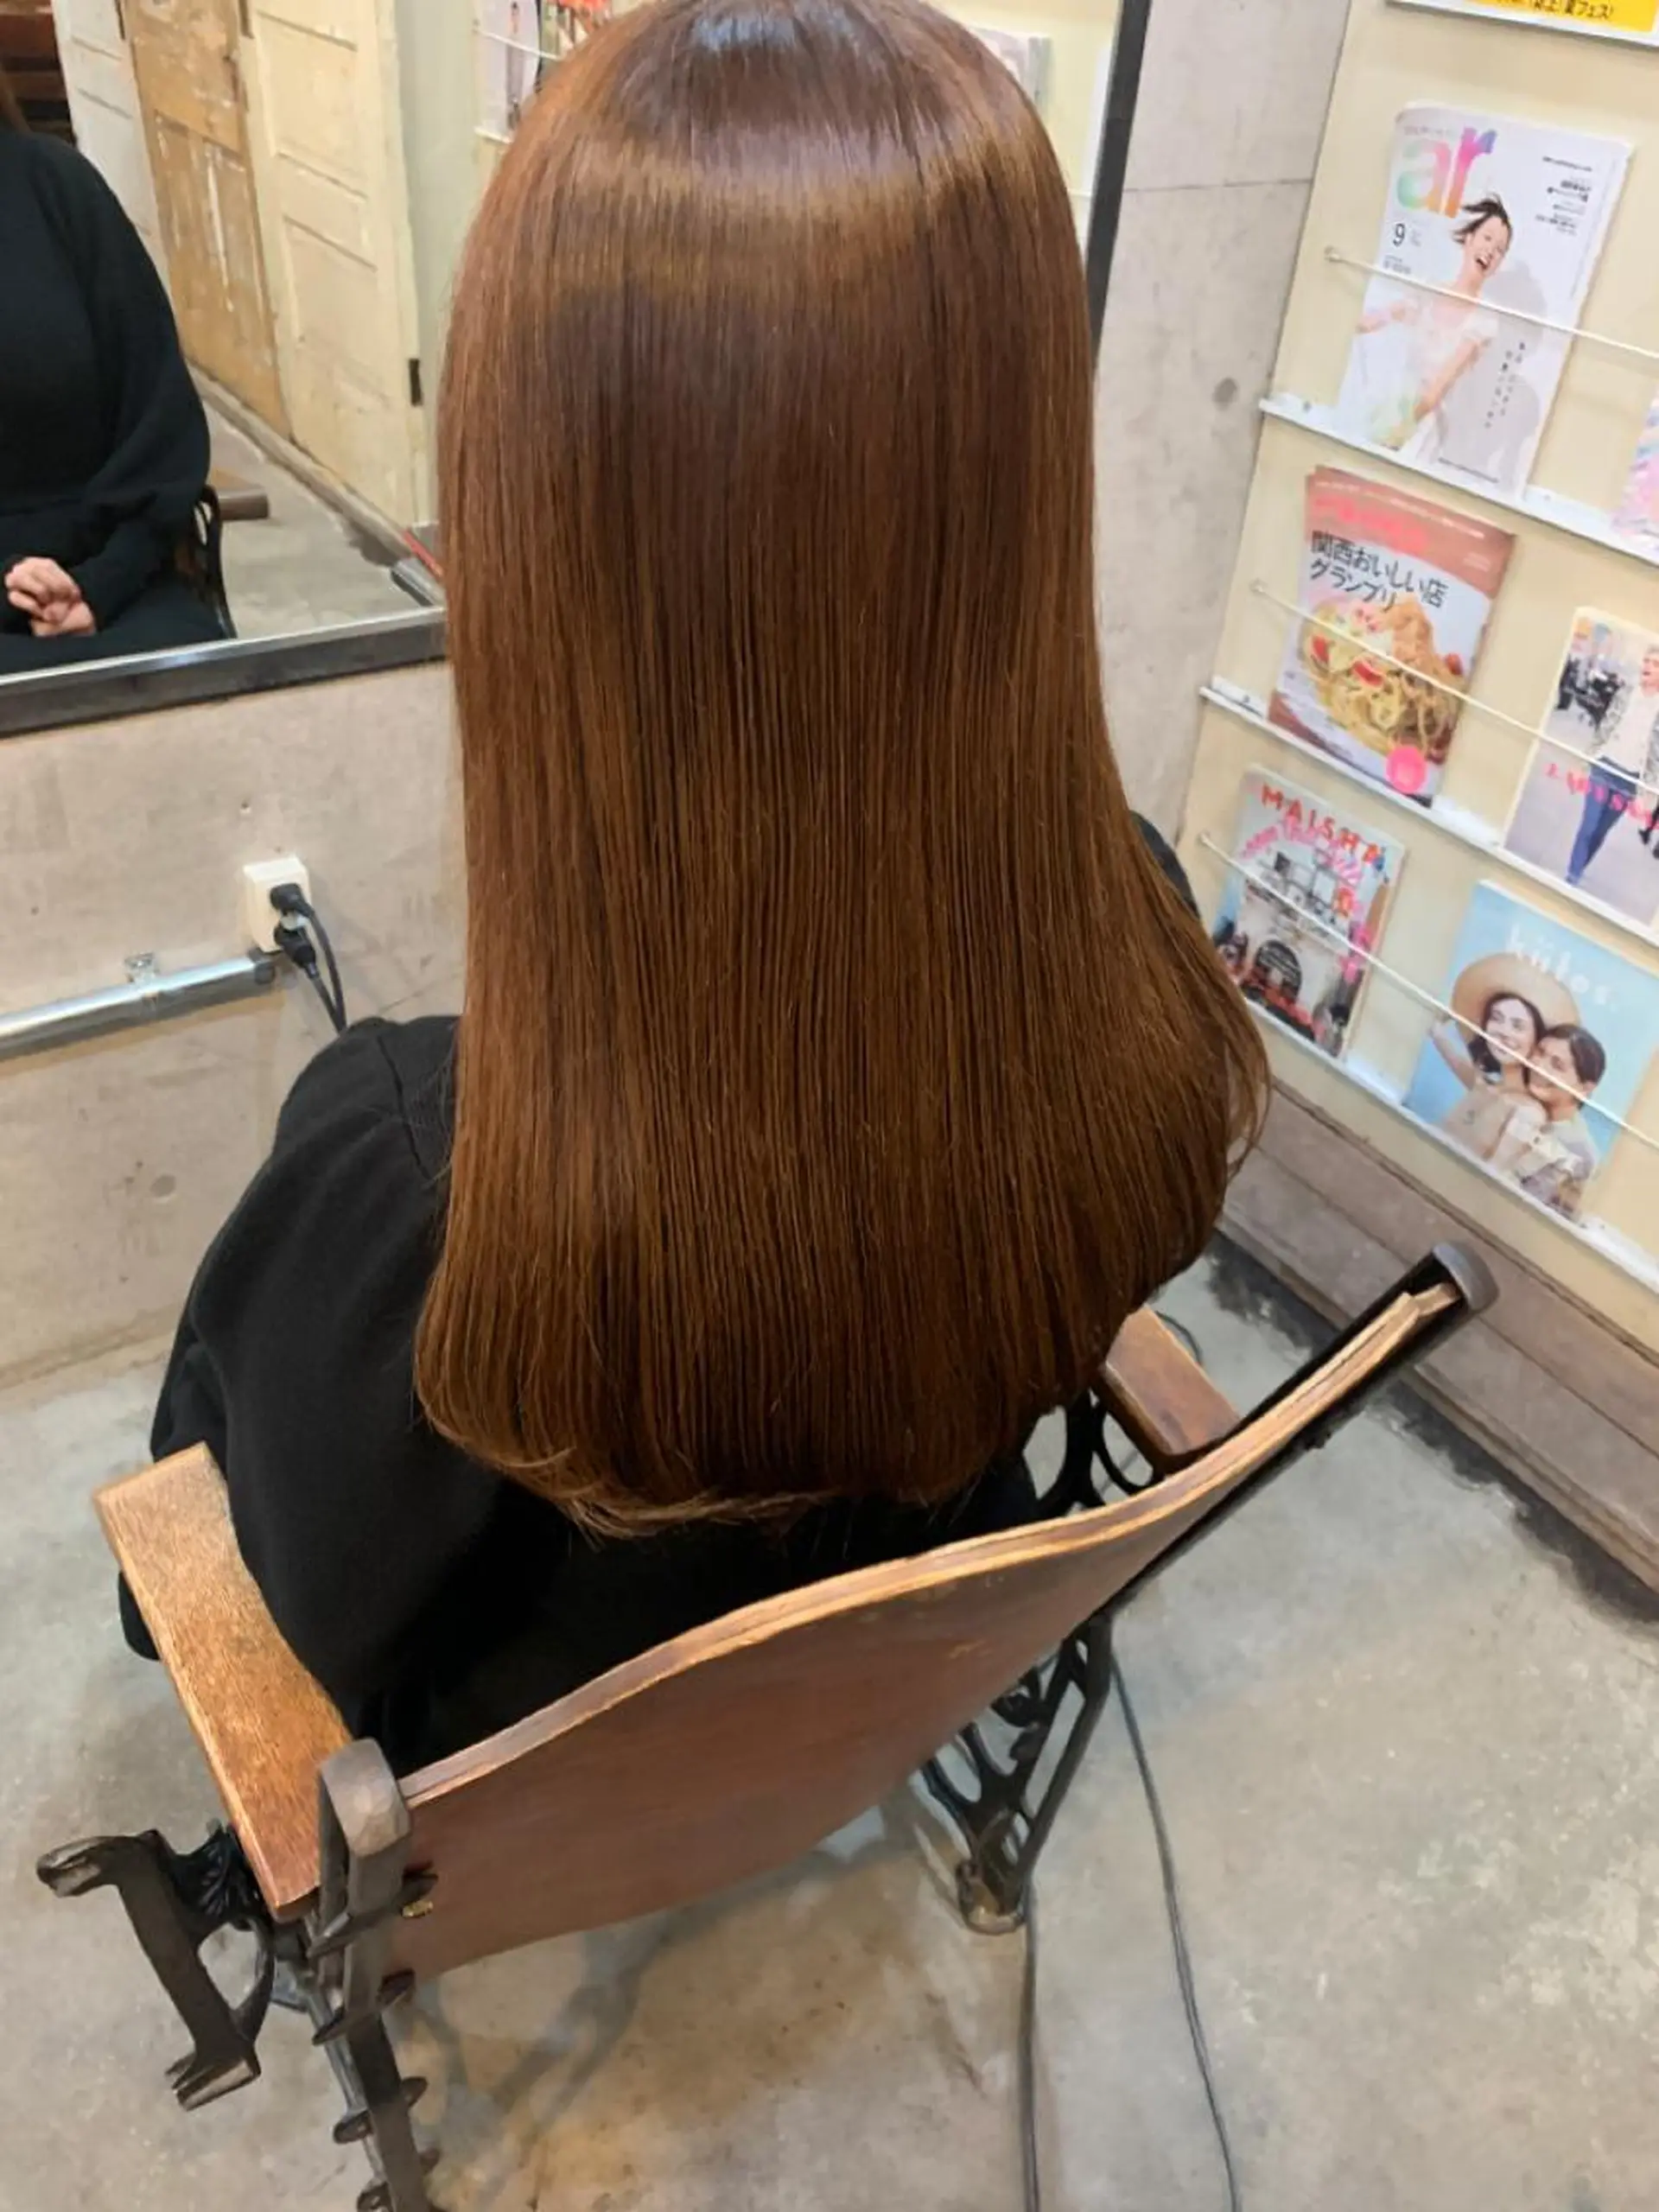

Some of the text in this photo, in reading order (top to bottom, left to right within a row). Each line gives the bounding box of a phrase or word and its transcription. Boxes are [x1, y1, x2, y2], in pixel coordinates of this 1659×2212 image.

[1396, 127, 1497, 219] ar
[1392, 223, 1406, 248] 9
[1310, 558, 1397, 613] グランプリ
[1311, 530, 1449, 608] 関西おいしい店
